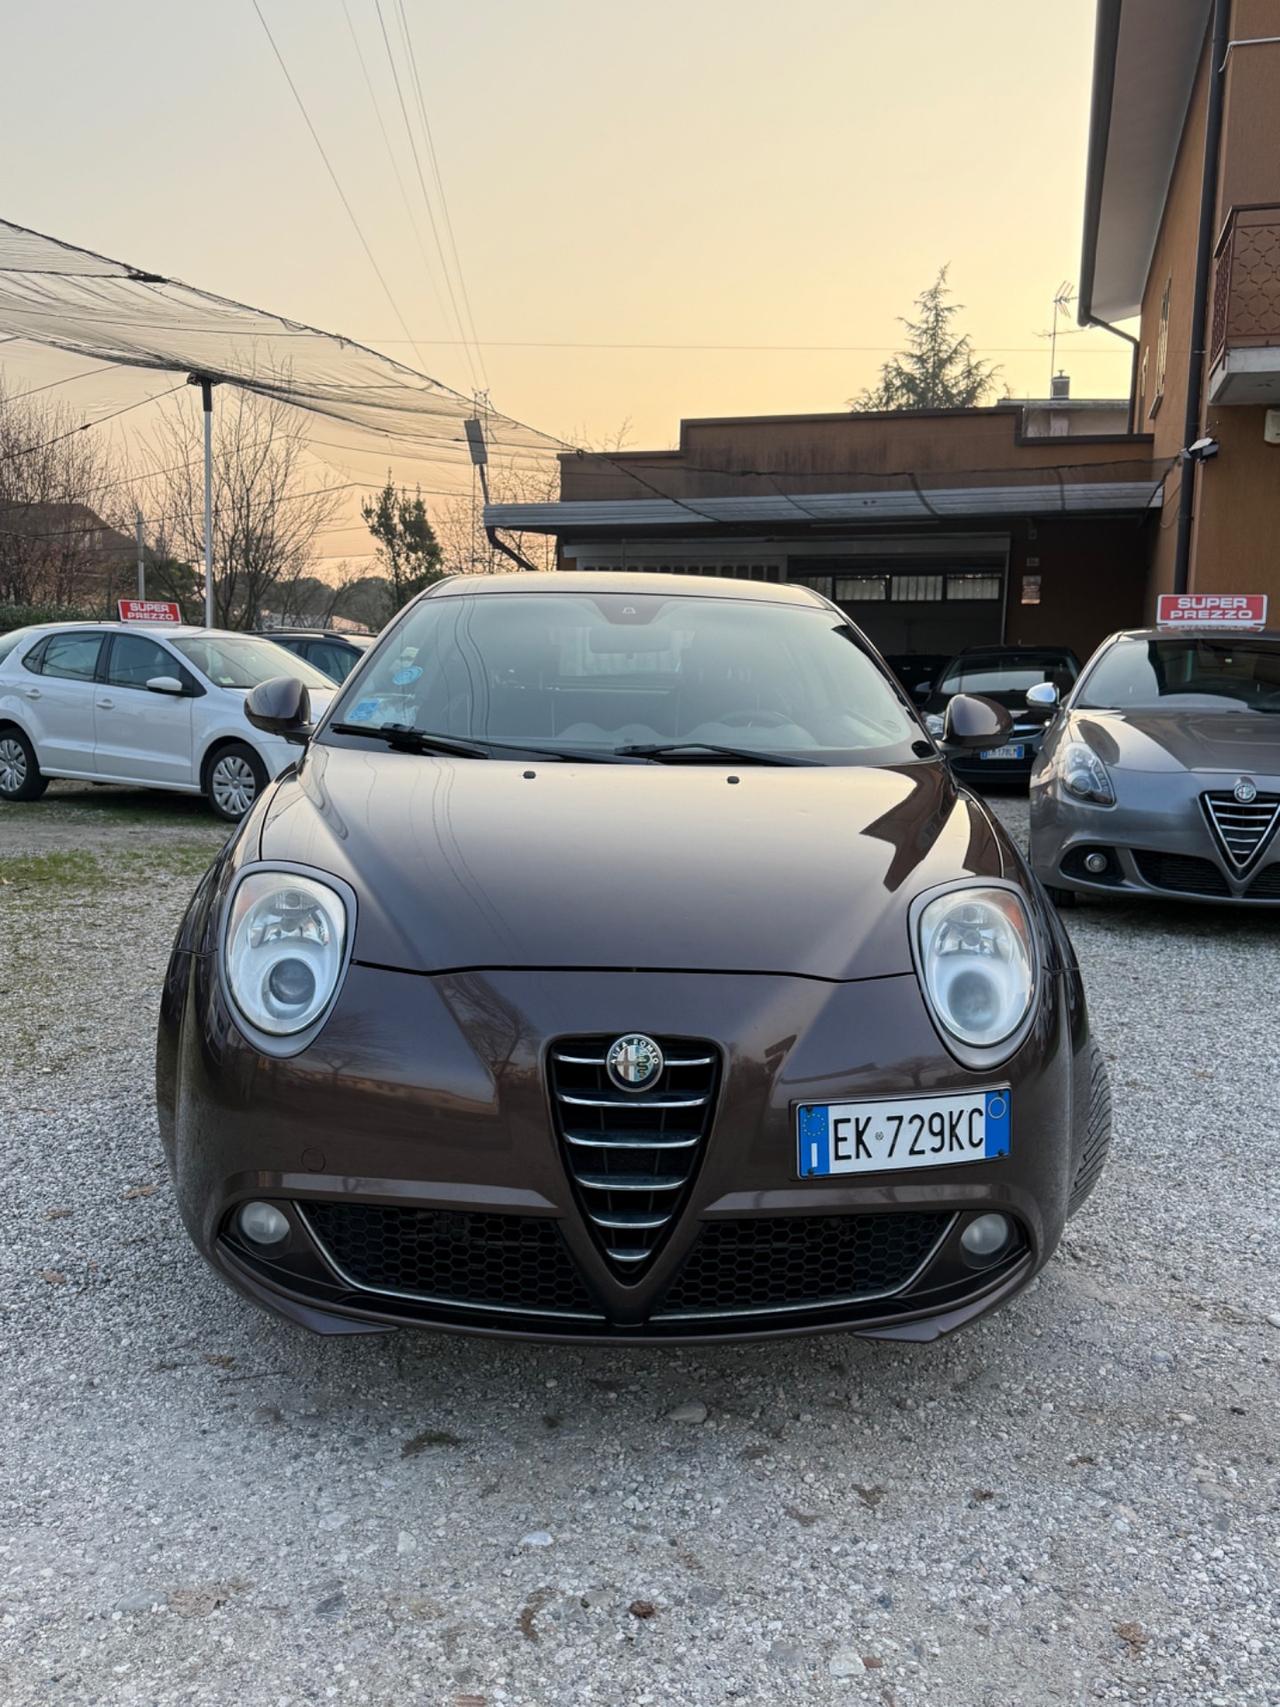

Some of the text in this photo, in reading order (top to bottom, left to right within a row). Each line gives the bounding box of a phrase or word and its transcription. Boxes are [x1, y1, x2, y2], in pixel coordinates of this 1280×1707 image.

[129, 602, 170, 613] SUPER
[1177, 597, 1248, 609] SUPER
[127, 611, 175, 620] PREZZO
[1170, 610, 1253, 619] PREZZO
[610, 1038, 659, 1065] ALFA ROMEO
